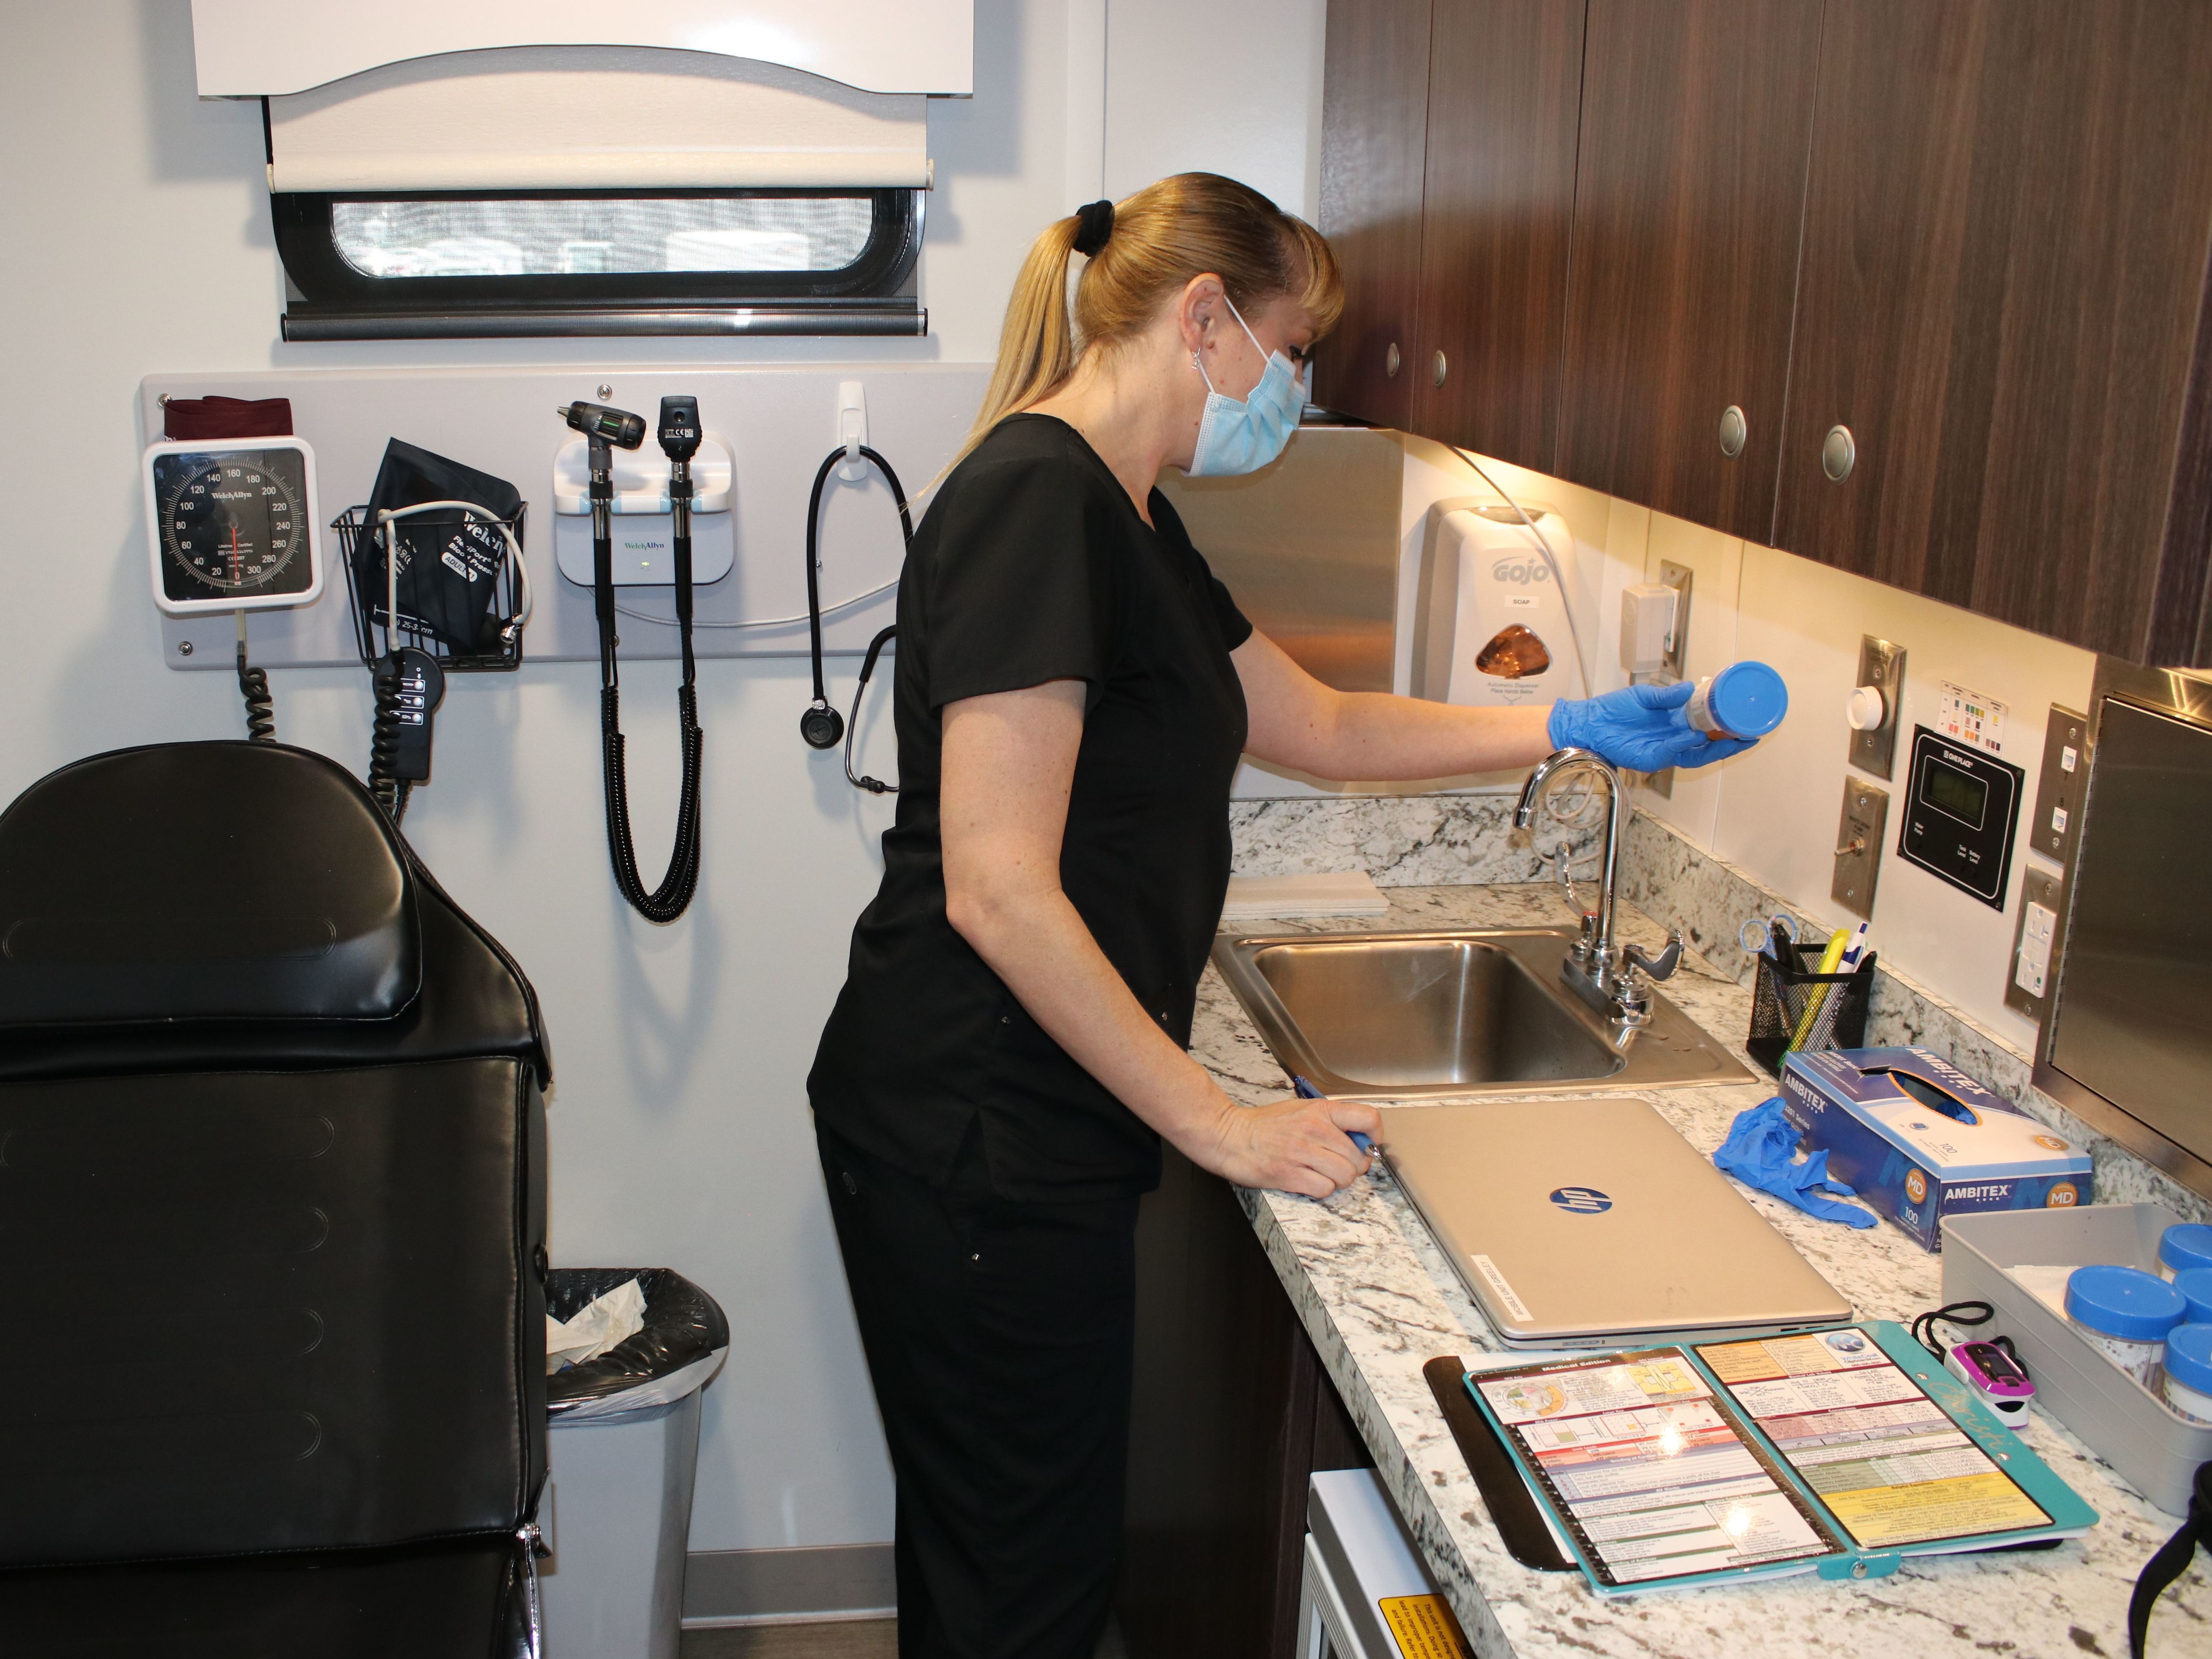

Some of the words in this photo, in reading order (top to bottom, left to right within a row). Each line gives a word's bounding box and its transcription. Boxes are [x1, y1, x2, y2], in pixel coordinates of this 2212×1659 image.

[227, 469, 240, 477] 160
[207, 474, 221, 482] 140
[246, 475, 260, 484] 180
[190, 485, 205, 494] 120
[262, 487, 276, 495] 200
[180, 502, 194, 511] 100
[273, 502, 286, 511] 220
[176, 521, 186, 530] 80
[276, 521, 290, 530] 240
[182, 541, 191, 550] 60
[272, 540, 286, 549] 260
[194, 557, 204, 566] 40
[262, 555, 276, 563] 280
[212, 567, 222, 576] 20
[247, 566, 261, 574] 300
[2063, 772, 2068, 781] 7
[2059, 797, 2065, 807] 8
[1905, 1048, 1991, 1096] AMBITEX
[1785, 1073, 1827, 1114] AMBITEX
[1795, 1113, 1810, 1130] Series
[1941, 1143, 1958, 1154] 100
[1907, 1175, 1924, 1195] MD
[1944, 1185, 2009, 1201] AMBITEX
[1556, 1189, 1612, 1211] hp
[2050, 1192, 2074, 1205] MD
[1906, 1206, 1918, 1224] 100
[1480, 1261, 1501, 1284] GREELEY
[1497, 1284, 1510, 1295] UNIT
[1505, 1296, 1524, 1316] MOBILE
[1541, 1363, 1578, 1372] Medical
[1399, 1600, 1409, 1611] lead
[1408, 1618, 1423, 1642] improper
[1424, 1603, 1433, 1614] This
[1429, 1614, 1439, 1625] unit
[1437, 1630, 1446, 1640] not
[1391, 1608, 1401, 1619] and
[1396, 1619, 1408, 1637] failure.
[1405, 1638, 1416, 1651] Refer
[1412, 1604, 1431, 1635] installations.
[1429, 1636, 1439, 1651] Doing
